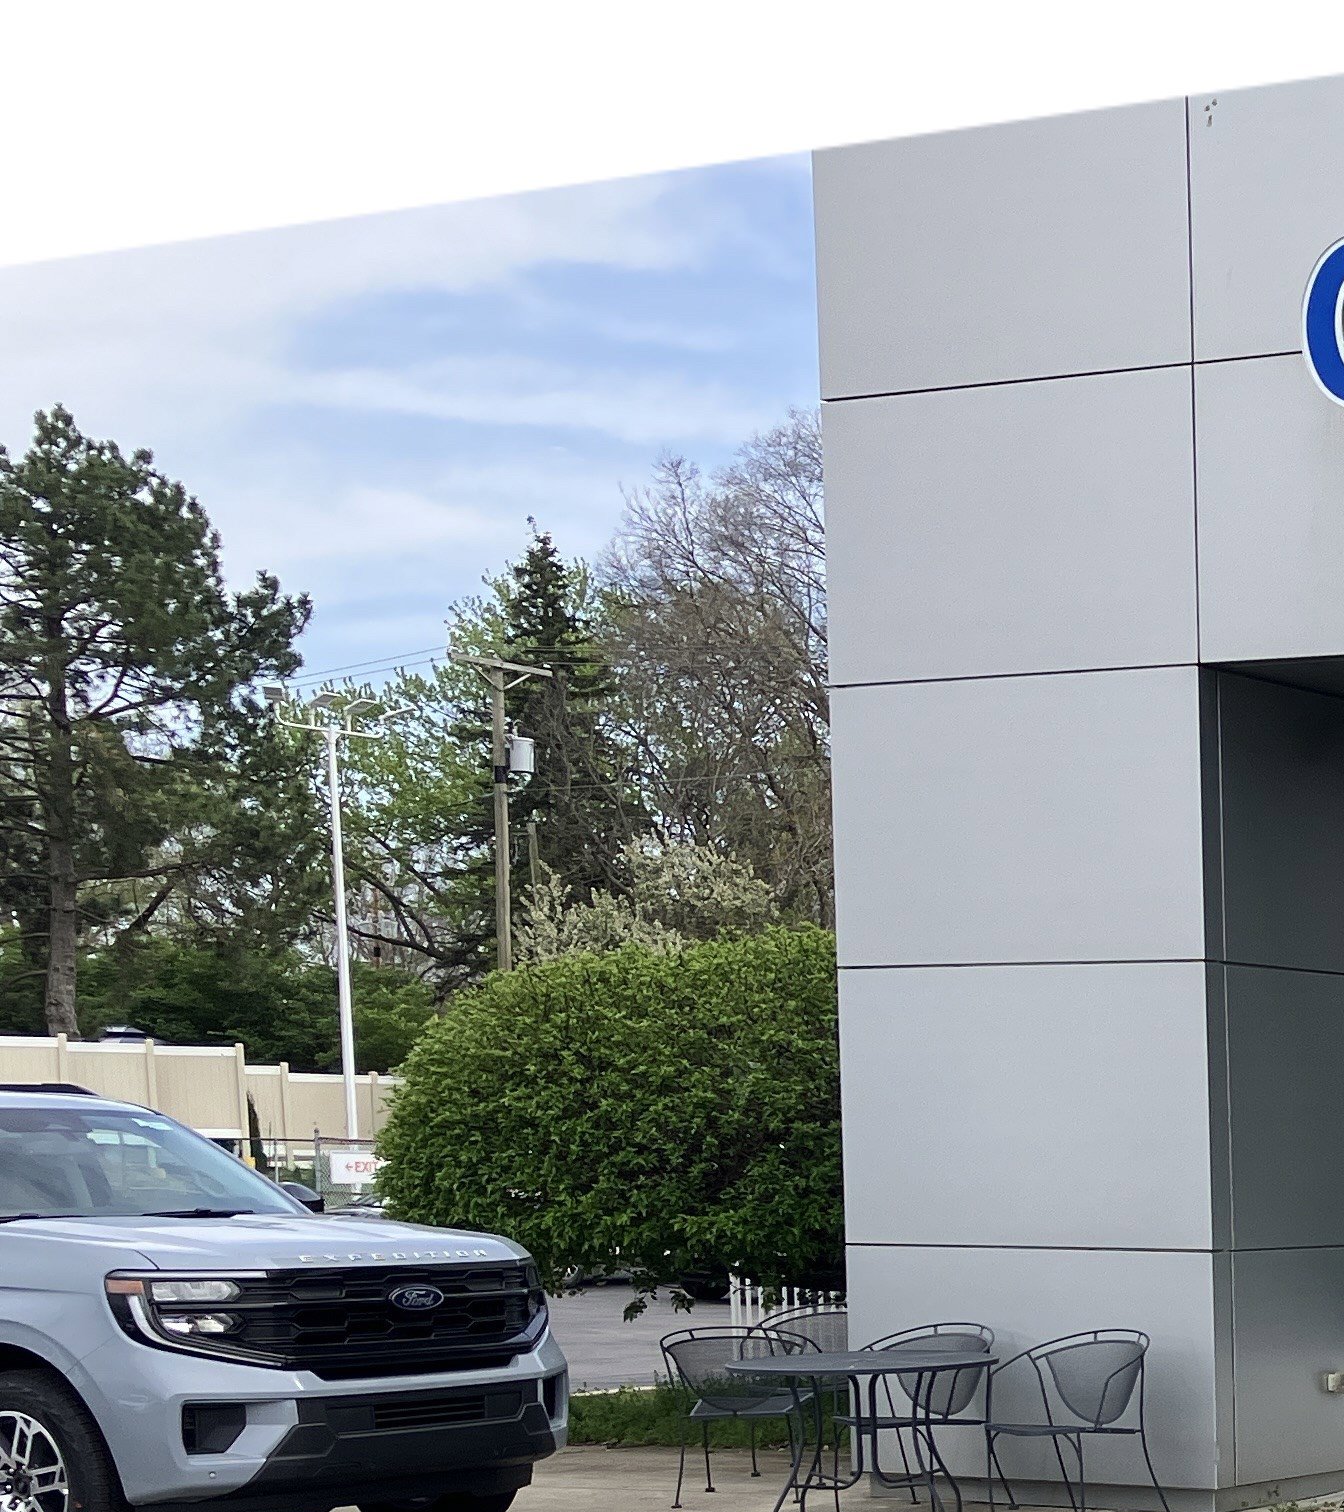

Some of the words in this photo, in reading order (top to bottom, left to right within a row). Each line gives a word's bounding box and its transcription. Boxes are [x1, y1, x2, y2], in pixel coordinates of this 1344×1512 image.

[354, 1161, 379, 1173] EXIT
[298, 1248, 488, 1264] EXPEDITION
[402, 1290, 436, 1307] Ford
